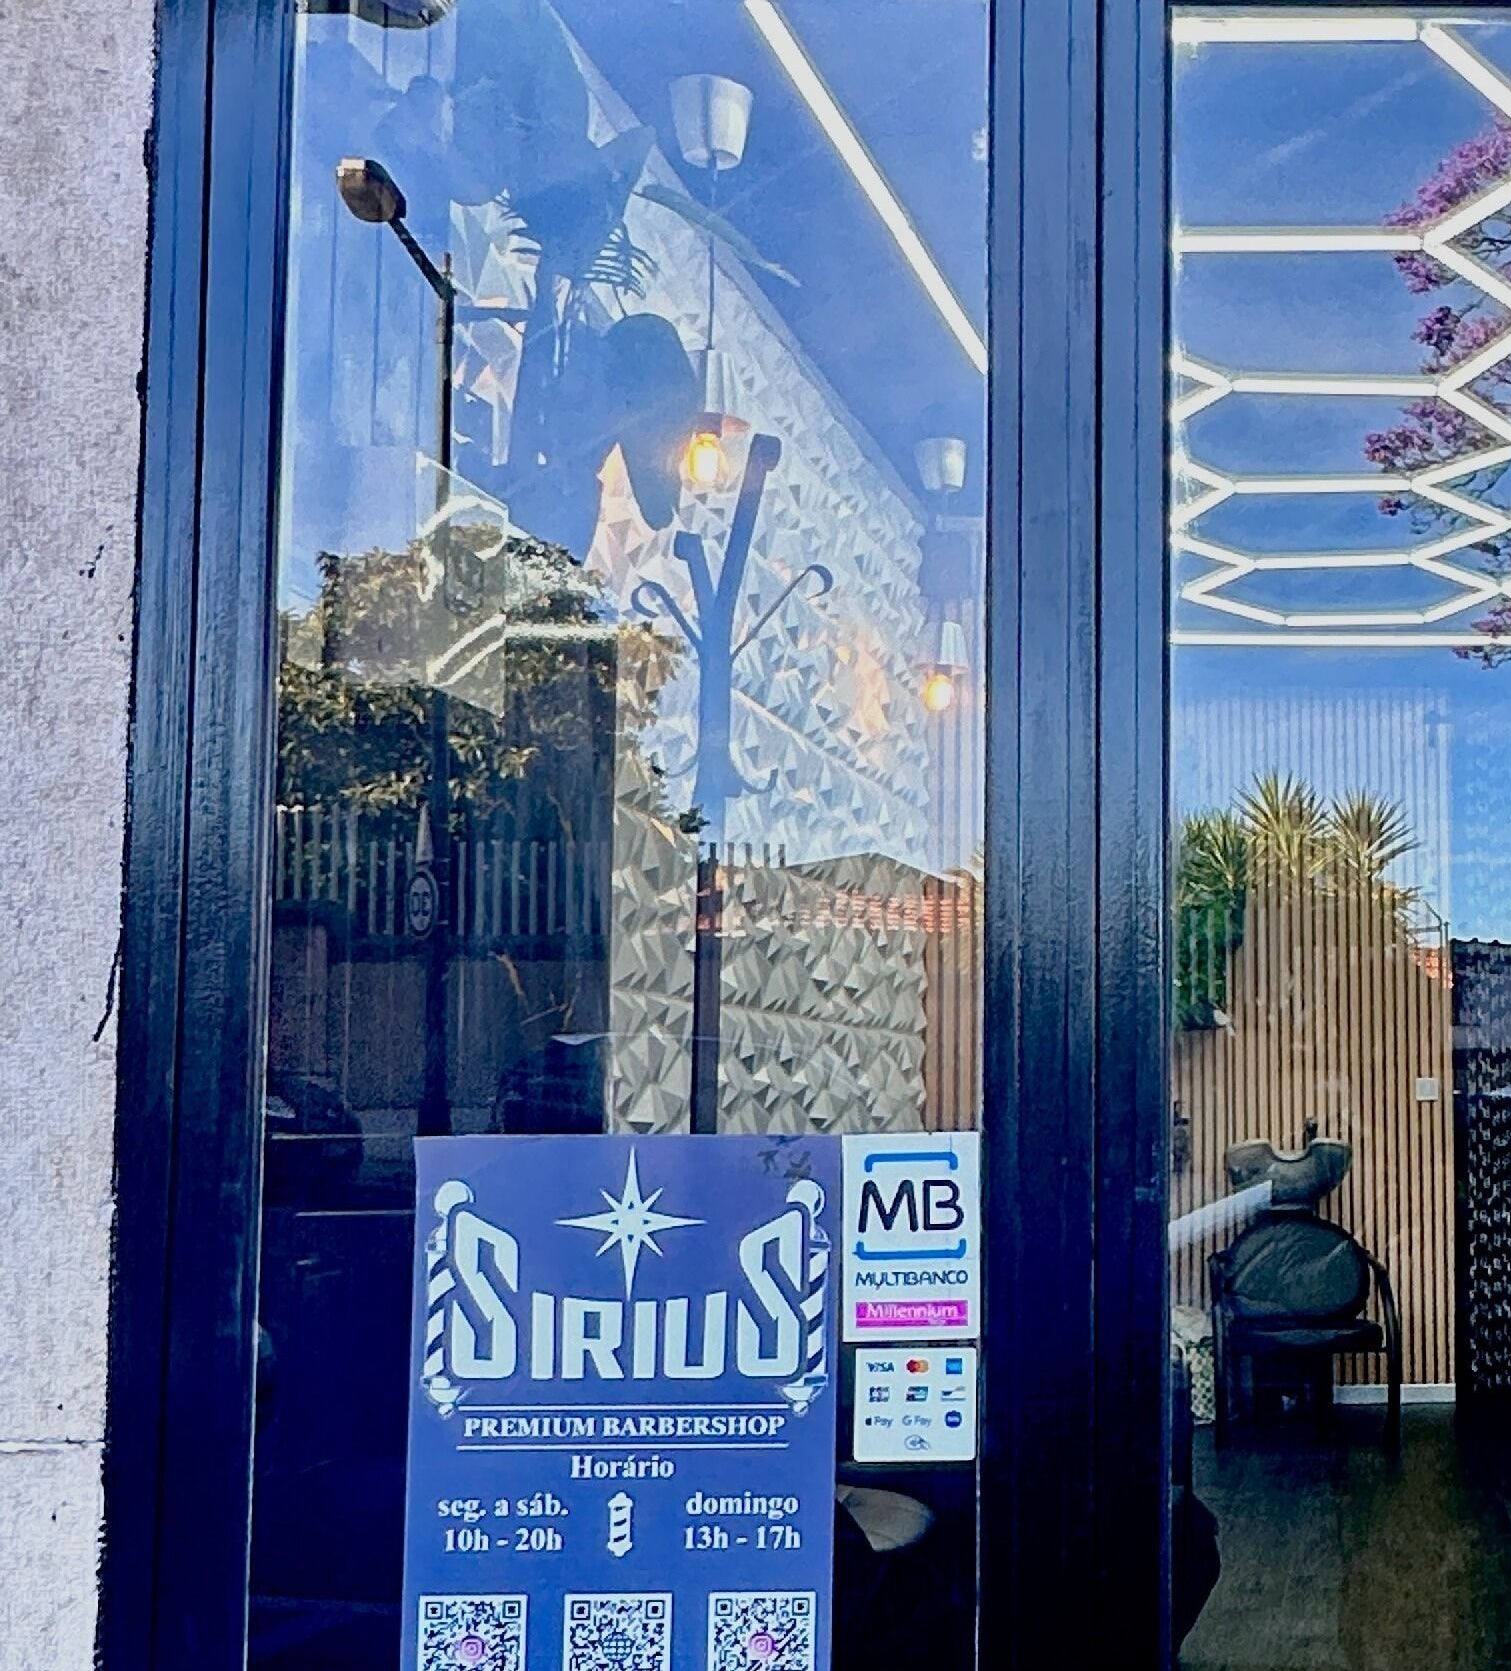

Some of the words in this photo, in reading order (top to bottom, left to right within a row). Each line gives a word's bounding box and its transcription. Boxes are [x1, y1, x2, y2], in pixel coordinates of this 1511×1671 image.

[858, 1180, 964, 1233] MB
[856, 1270, 968, 1288] MULTIBANCO
[451, 1209, 804, 1379] SIRIUS
[866, 1303, 958, 1318] Millennium
[464, 1417, 596, 1437] PREMIUM
[603, 1415, 785, 1437] BARBERSHOP
[570, 1455, 676, 1479] Horário
[438, 1499, 487, 1523] seg.
[494, 1499, 510, 1517] a
[516, 1493, 569, 1517] sáb.
[685, 1491, 800, 1520] domingo
[445, 1528, 490, 1552] 10h
[515, 1528, 563, 1552] 20h
[684, 1526, 729, 1550] 13h
[756, 1525, 801, 1550] 17h
